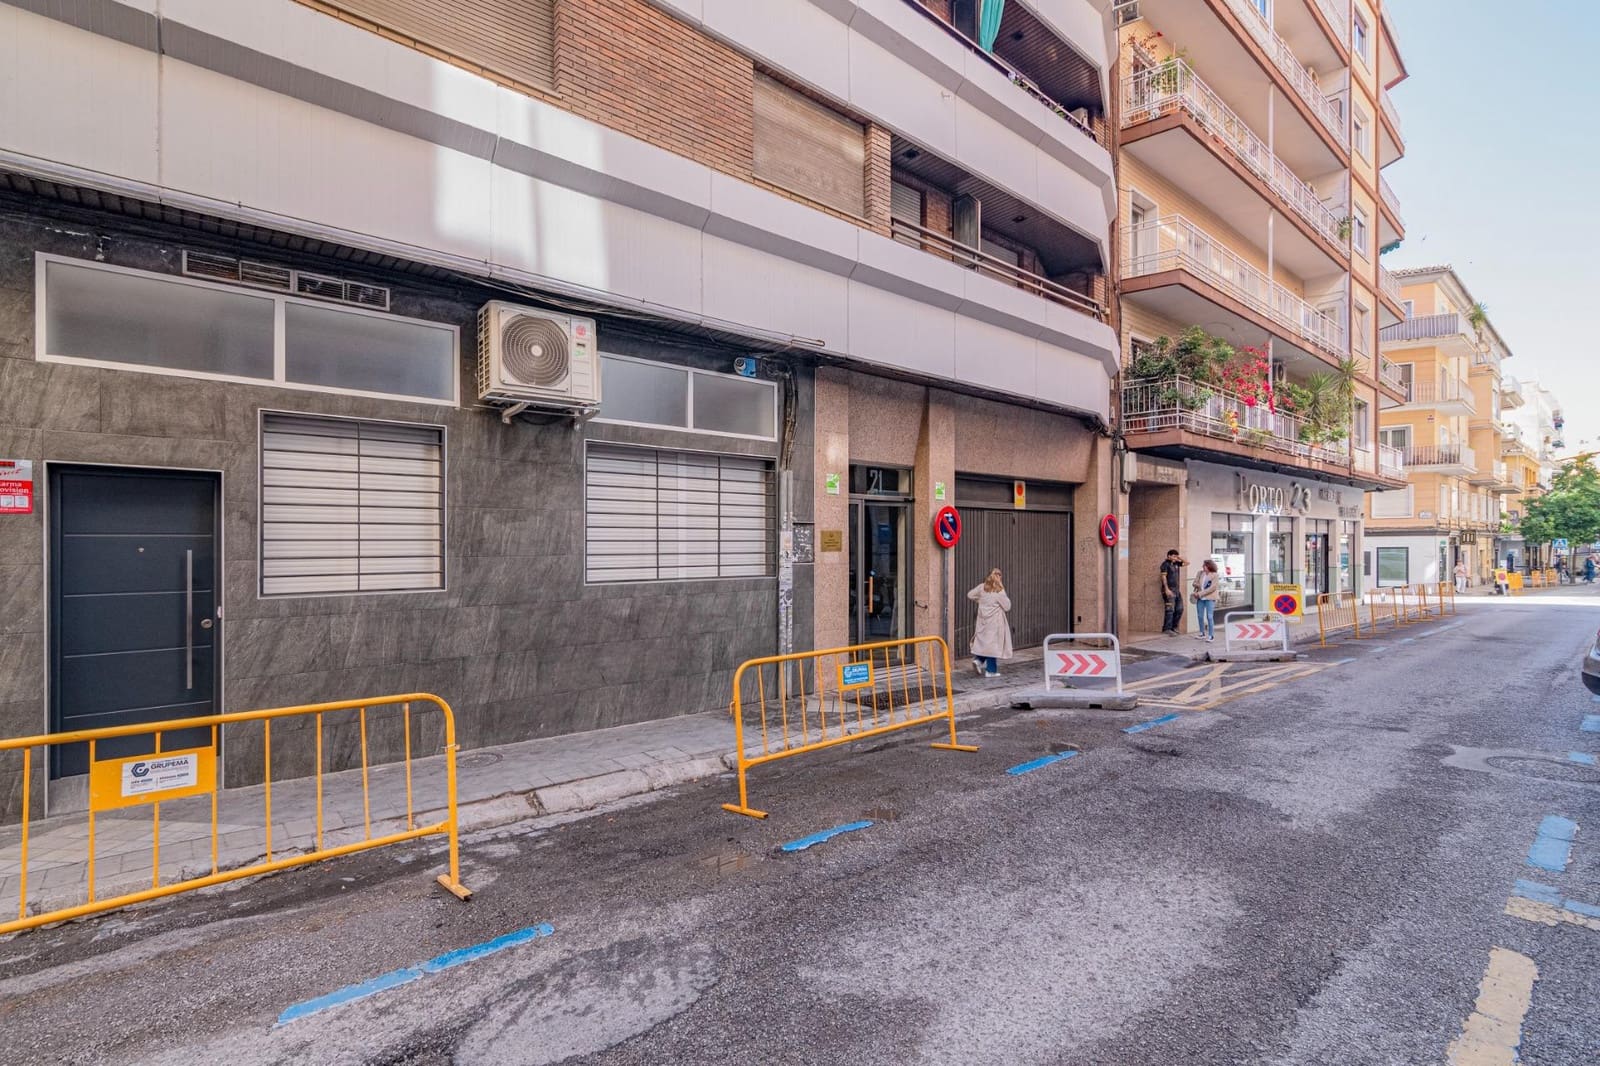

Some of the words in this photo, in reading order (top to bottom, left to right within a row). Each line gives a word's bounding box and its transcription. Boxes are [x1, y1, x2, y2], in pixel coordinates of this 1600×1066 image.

[868, 469, 883, 493] 21
[1291, 482, 1311, 514] 23
[150, 759, 189, 769] GRUPEMA
